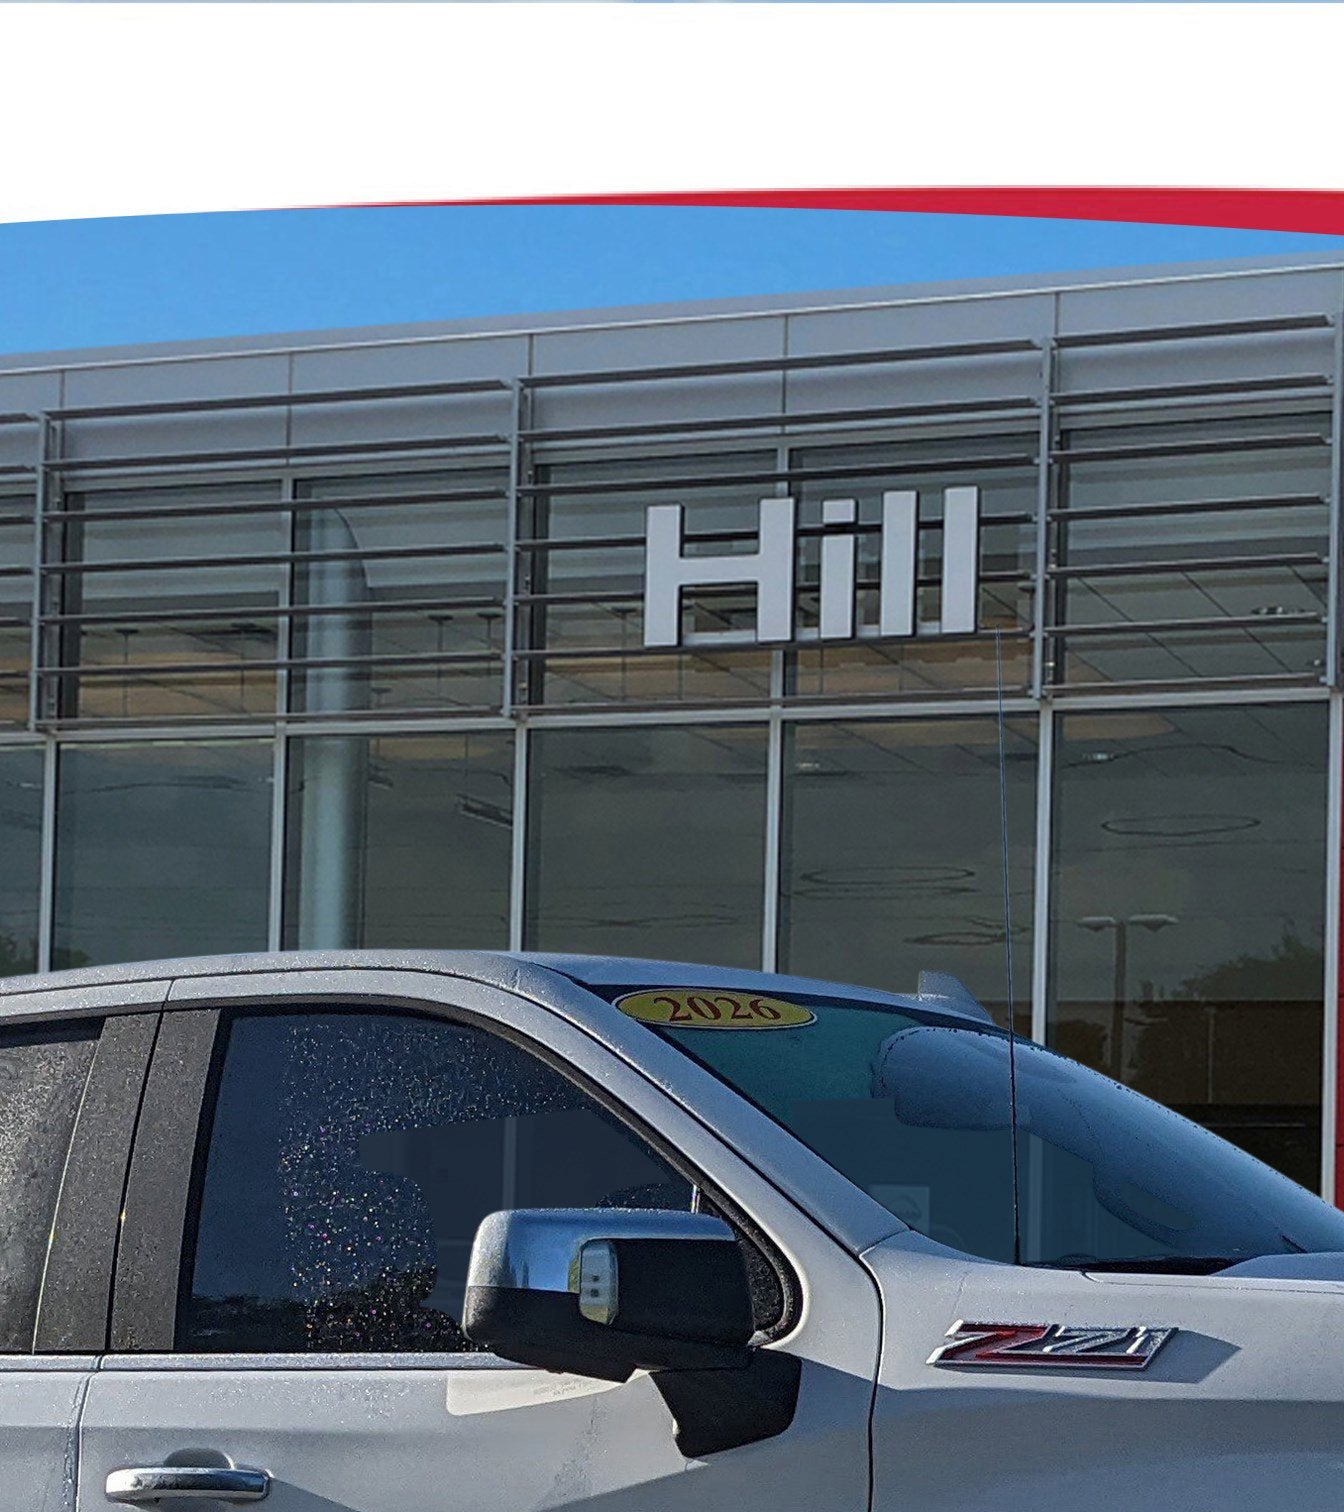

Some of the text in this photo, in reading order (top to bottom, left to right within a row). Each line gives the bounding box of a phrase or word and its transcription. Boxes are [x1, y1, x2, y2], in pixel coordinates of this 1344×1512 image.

[644, 485, 979, 647] Hill
[653, 996, 782, 1022] 2026
[926, 1319, 1179, 1370] Z71
